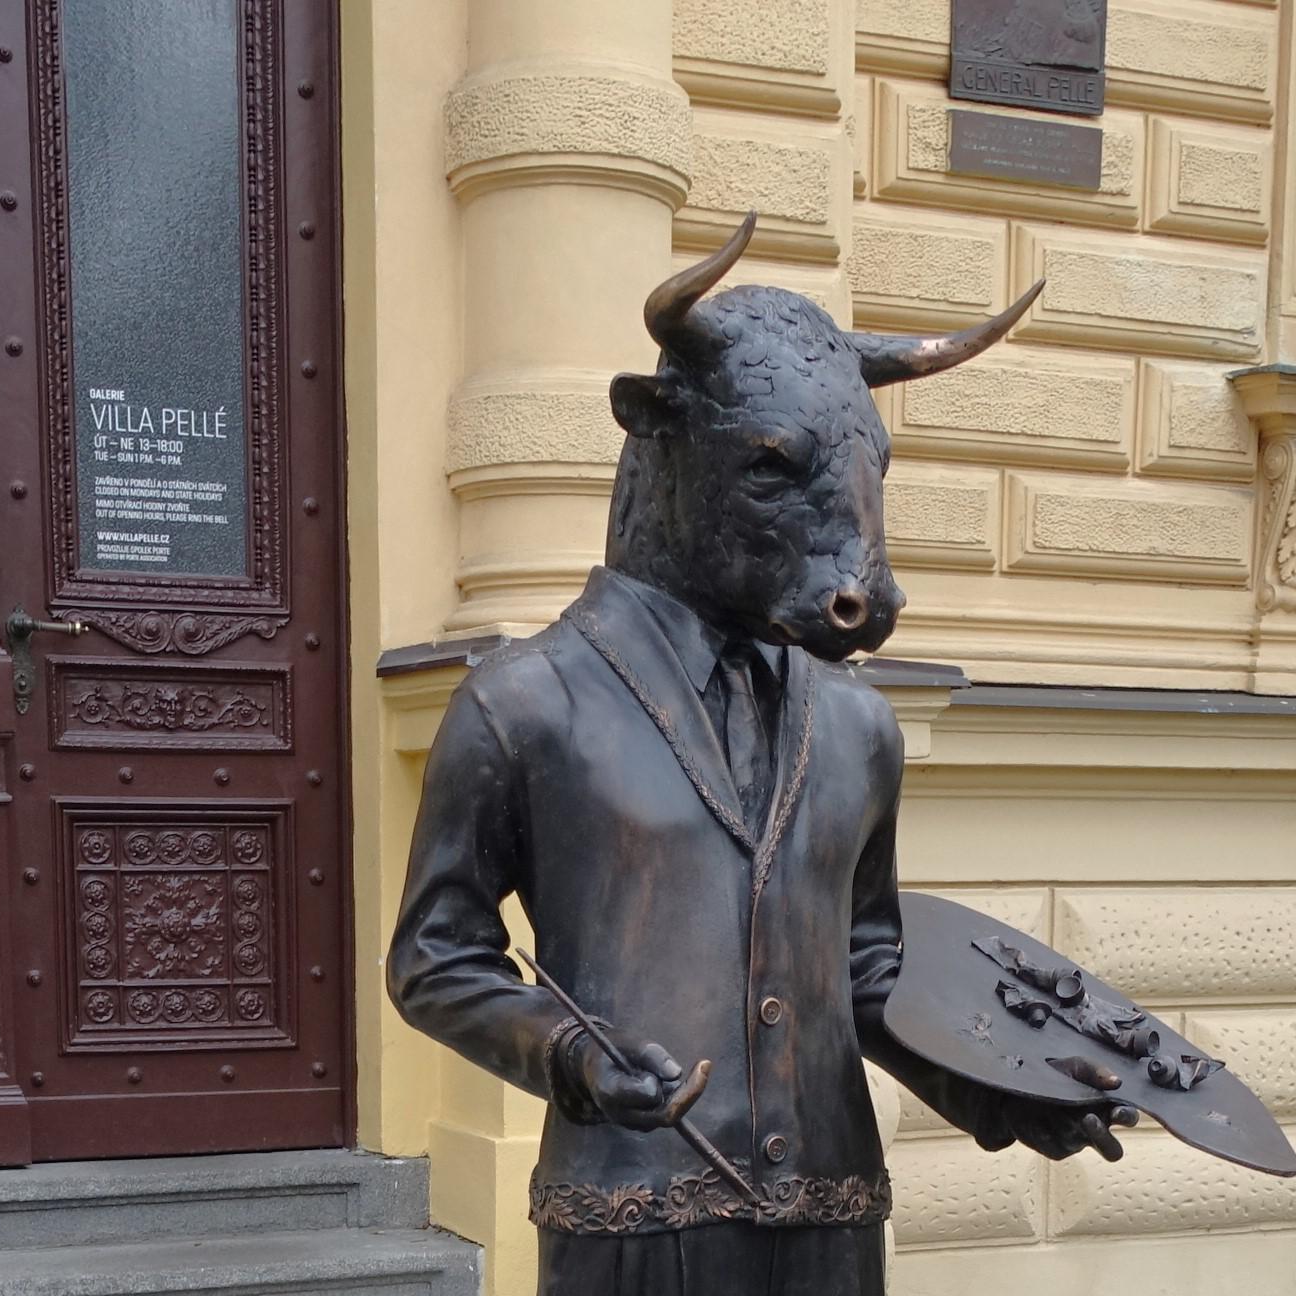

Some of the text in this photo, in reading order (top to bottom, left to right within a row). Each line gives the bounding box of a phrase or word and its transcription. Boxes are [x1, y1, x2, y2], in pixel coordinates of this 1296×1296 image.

[90, 388, 125, 401] GALERIE
[90, 403, 227, 438] VILLA PELLÉ
[94, 433, 107, 448] ÚT
[120, 437, 134, 450] NE
[94, 451, 108, 461] TUE
[117, 452, 133, 462] SUN
[157, 480, 161, 488] A
[162, 480, 167, 489] O
[95, 487, 222, 501] CLOSED ON MONDAYS AND STATE HOLIDAYS
[95, 498, 114, 508] MIMO
[143, 501, 166, 510] HODINY
[95, 509, 108, 518] OUT
[108, 510, 116, 518] OF
[117, 510, 142, 519] OPENING
[166, 513, 187, 522] PLEASE
[188, 514, 202, 523] RING
[203, 515, 214, 523] THE
[214, 515, 229, 524] BELL
[96, 531, 170, 543] WWW.VILLAPELLE.CZ
